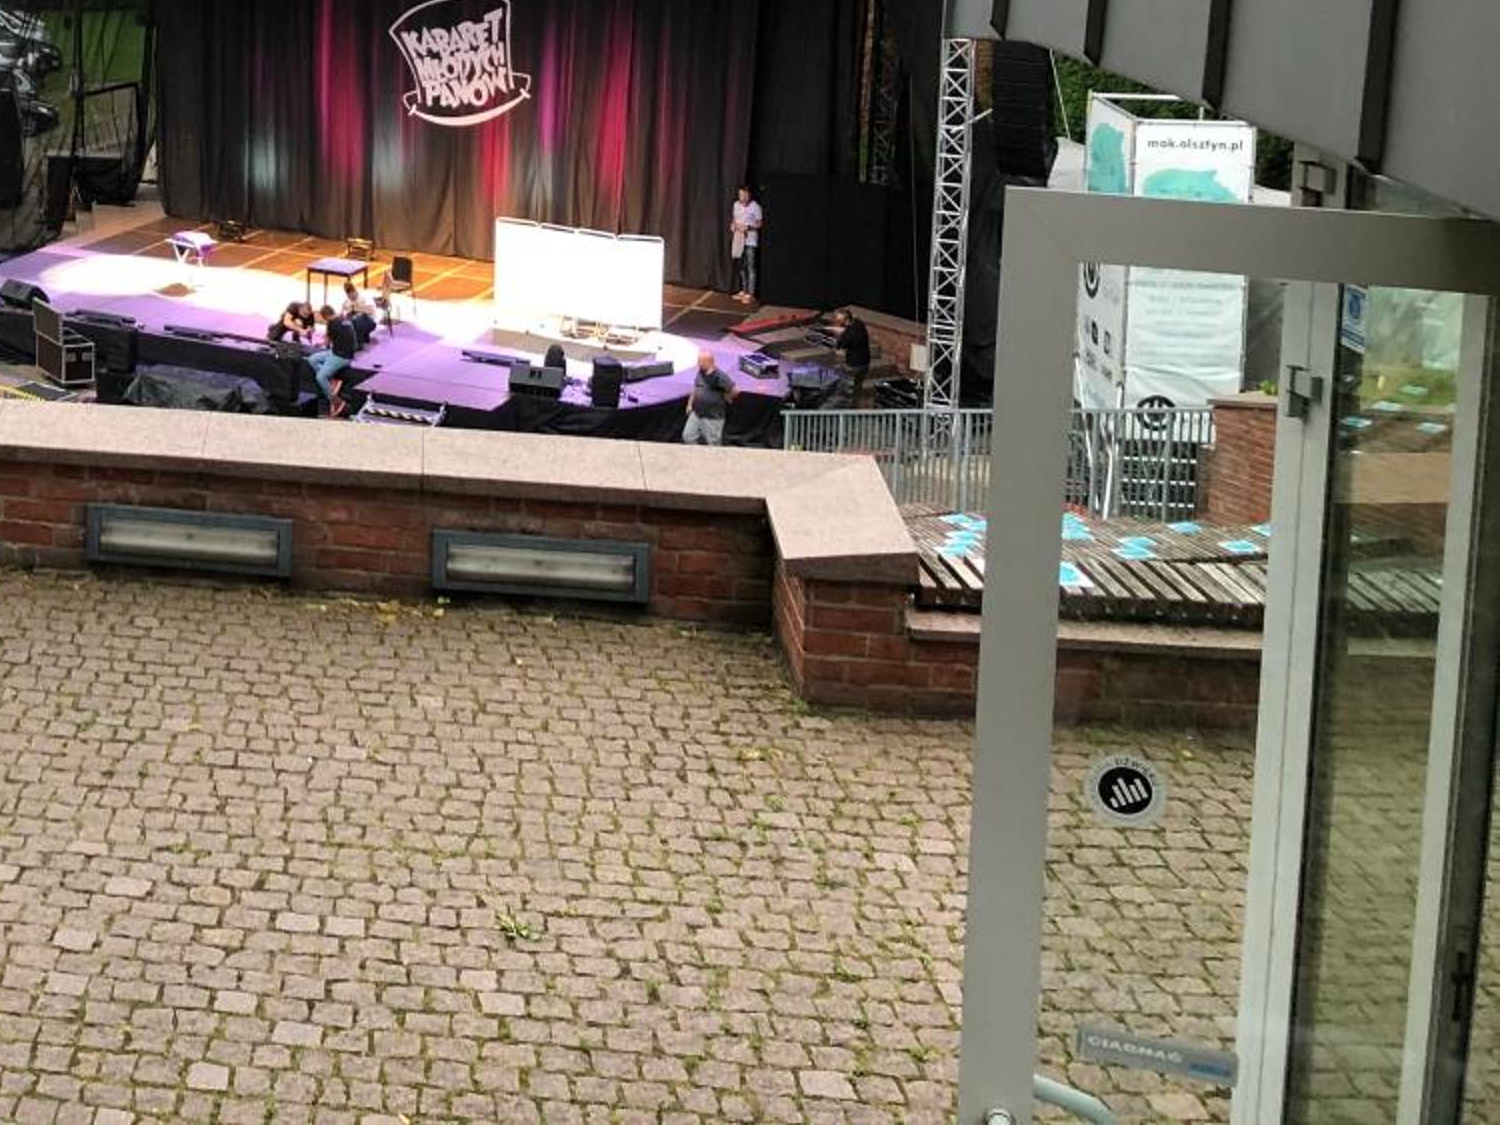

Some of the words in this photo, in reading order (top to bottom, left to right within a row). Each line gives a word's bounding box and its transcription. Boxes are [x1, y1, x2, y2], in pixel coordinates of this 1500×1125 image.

[401, 7, 503, 58] KABARET
[414, 40, 505, 81] MŁODYCH
[1147, 138, 1244, 153] mok.olsztyn.pl
